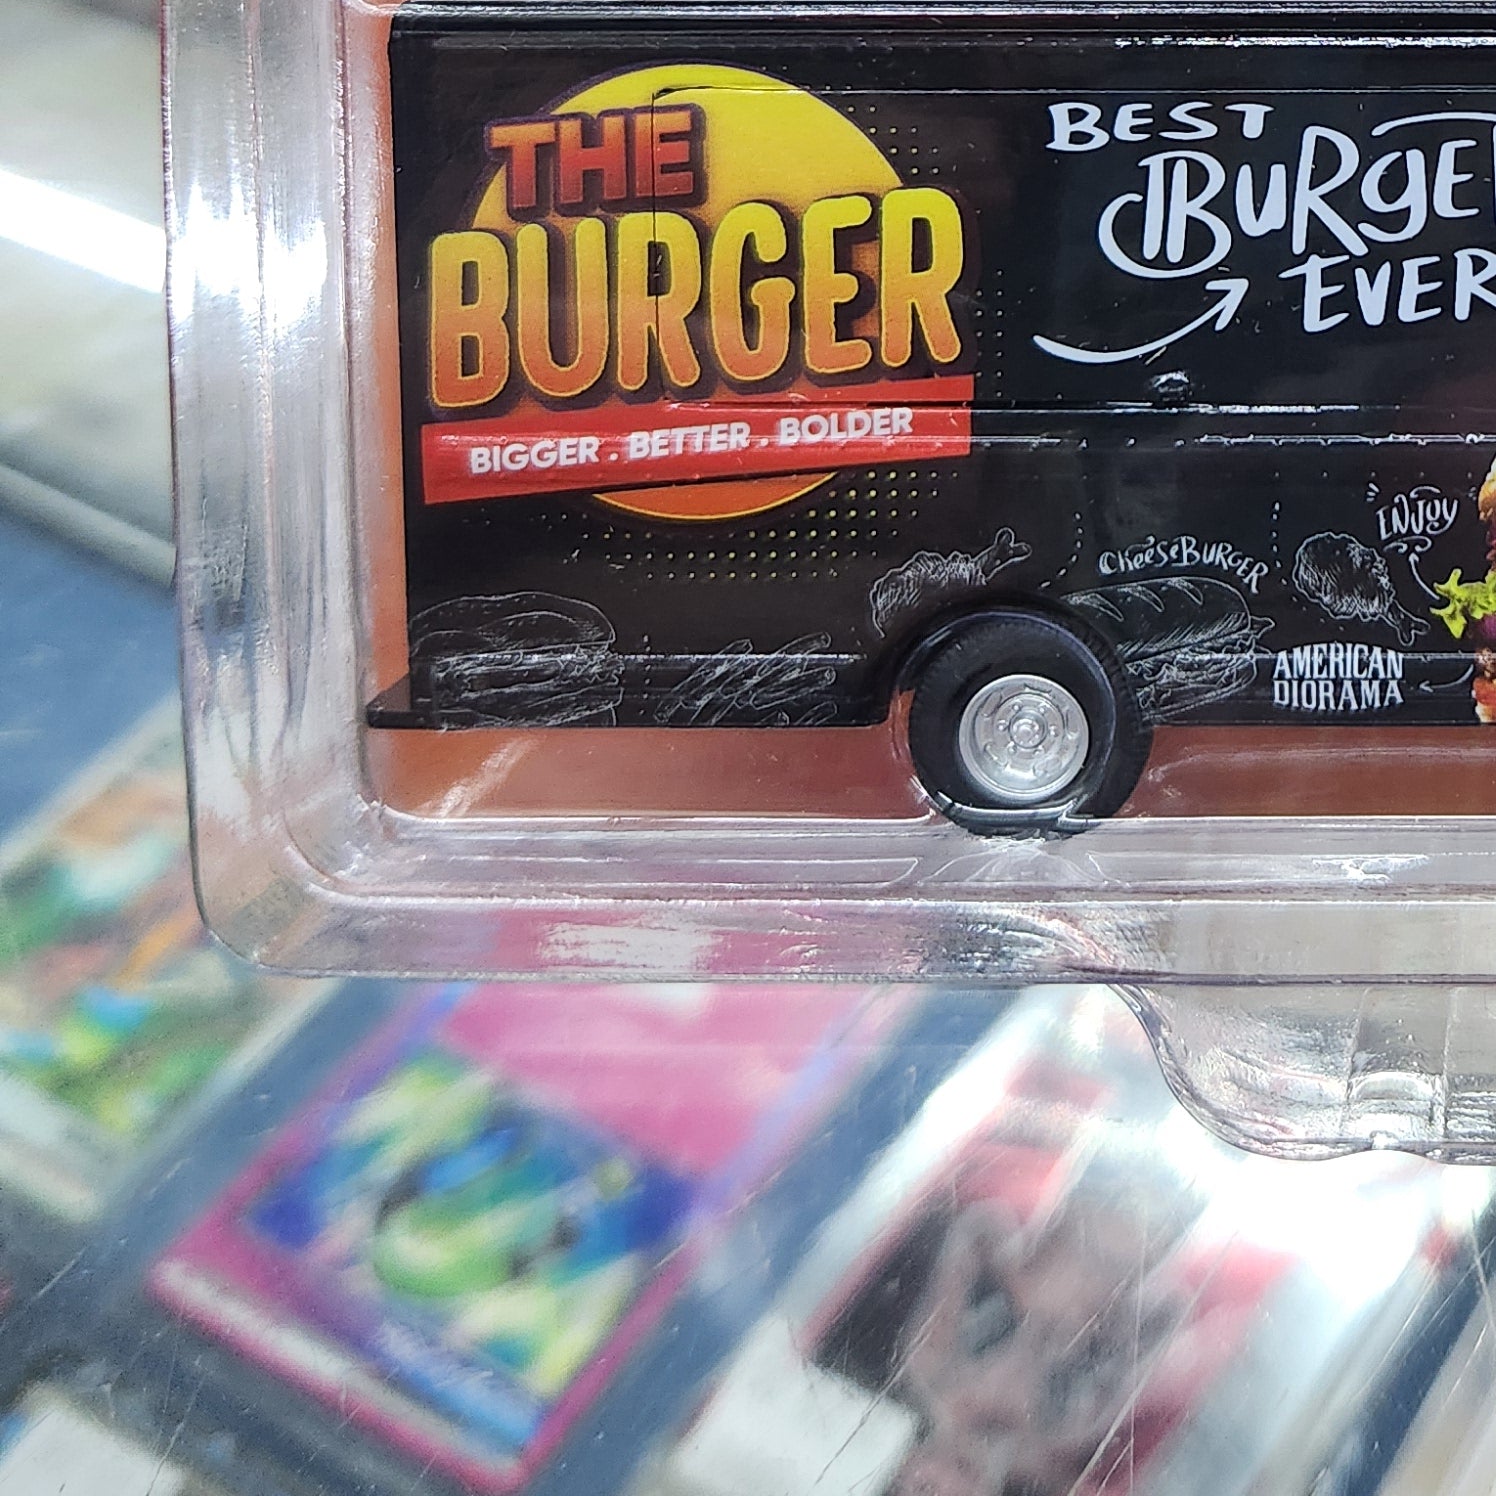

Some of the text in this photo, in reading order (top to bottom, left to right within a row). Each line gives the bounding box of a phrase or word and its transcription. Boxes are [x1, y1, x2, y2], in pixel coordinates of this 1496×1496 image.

[1046, 102, 1274, 152] BEST
[488, 108, 697, 208] THE
[430, 186, 965, 408] BURGER
[470, 407, 914, 474] BIGGER BETTER BOLDER
[1273, 642, 1404, 680] AMERICAN
[1273, 679, 1404, 712] DIORAMA
